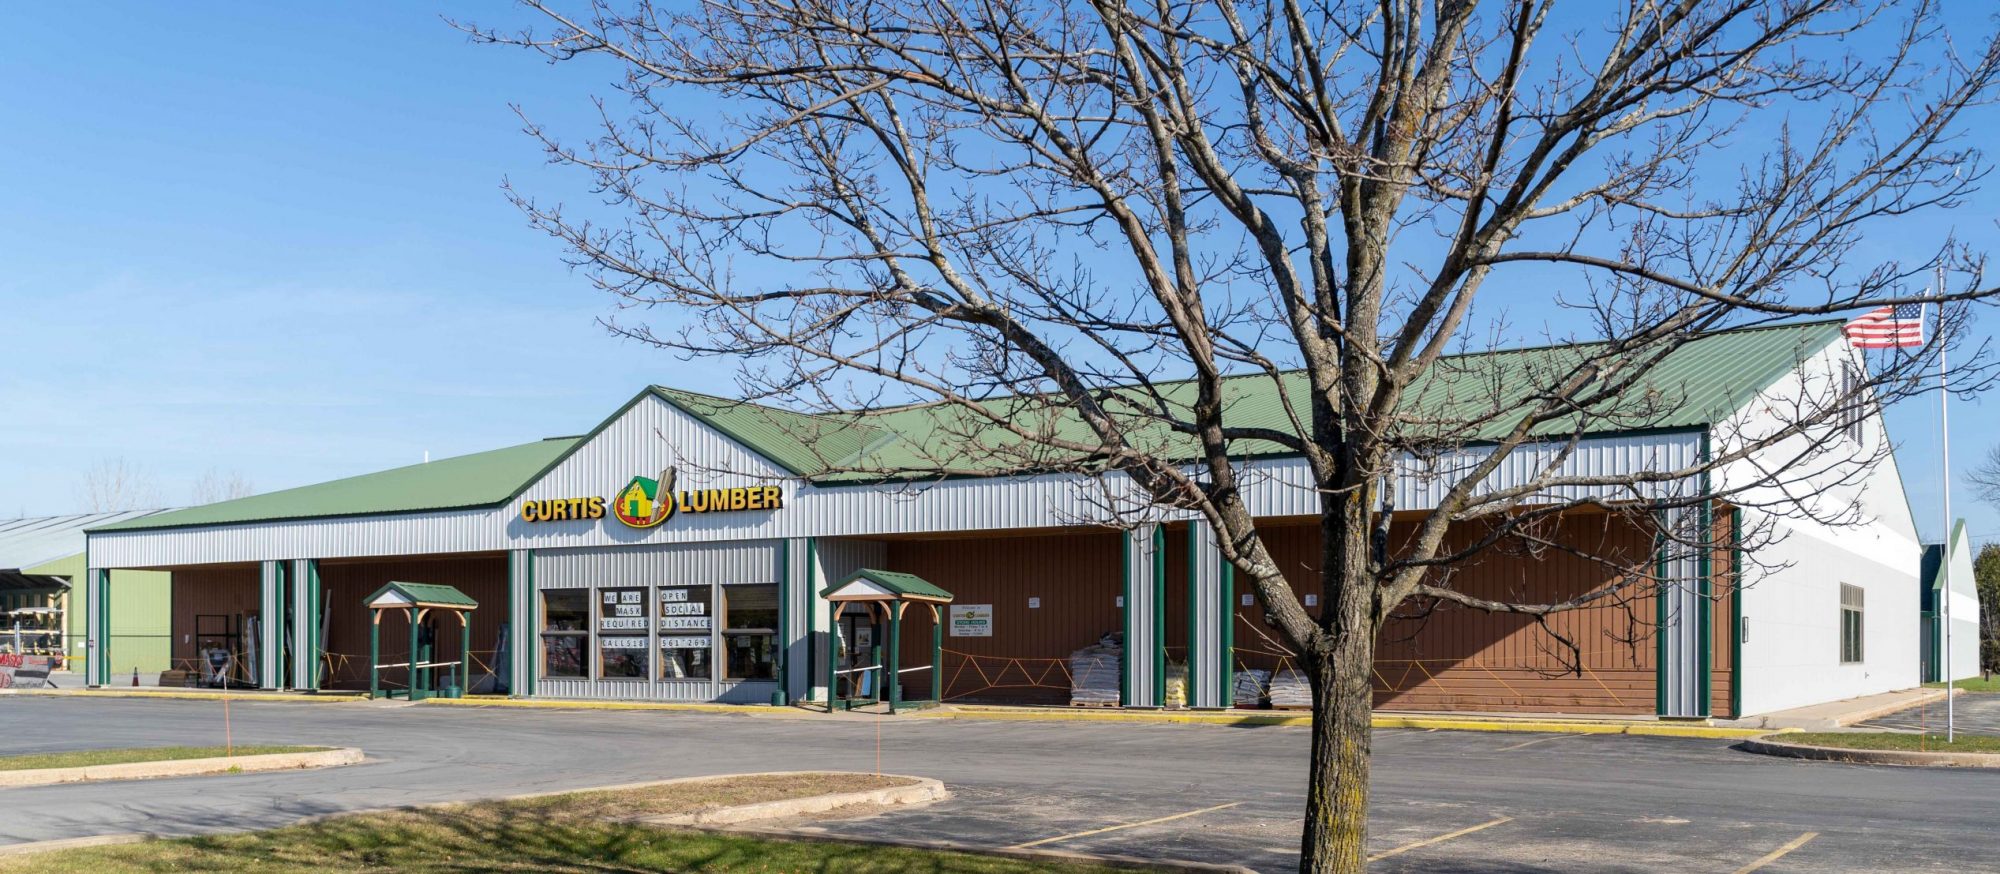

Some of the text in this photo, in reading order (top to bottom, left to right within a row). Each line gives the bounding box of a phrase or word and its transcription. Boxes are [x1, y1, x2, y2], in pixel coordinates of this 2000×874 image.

[521, 486, 782, 522] CURTIS LUMBER
[604, 592, 686, 602] WE ARE OPEN
[616, 607, 641, 615] MASK
[665, 605, 702, 613] SOCIAL
[600, 619, 649, 628] REQUIRED
[661, 618, 712, 627] DISTANCE
